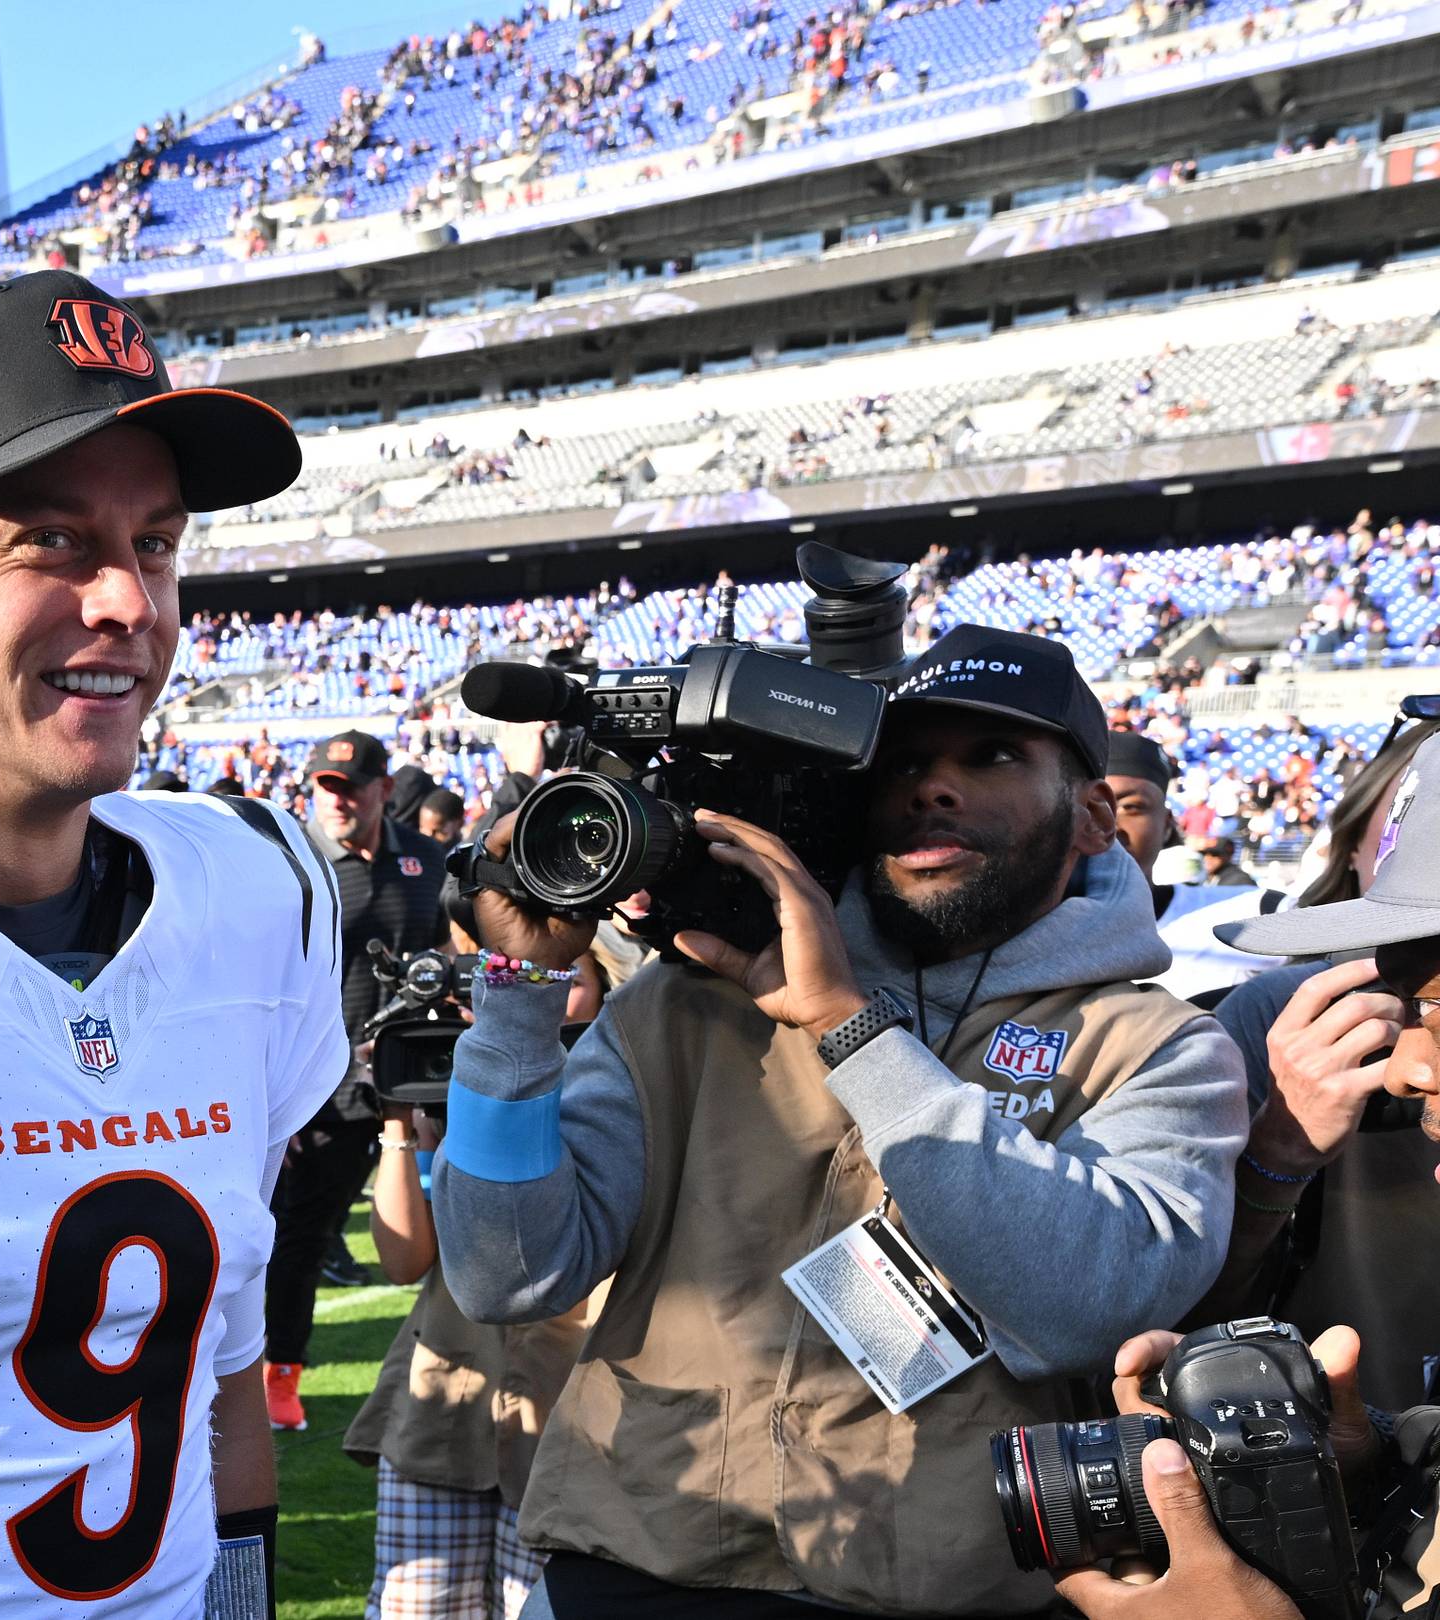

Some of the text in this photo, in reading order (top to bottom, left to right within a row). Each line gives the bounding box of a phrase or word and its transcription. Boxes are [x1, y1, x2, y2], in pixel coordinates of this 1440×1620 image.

[632, 675, 668, 684] SONY
[888, 659, 1022, 702] LULULEMON
[768, 689, 837, 716] XDCAM HD
[416, 972, 436, 981] JVC
[80, 1038, 115, 1069] NFL
[992, 1046, 1051, 1073] NFL
[6, 1169, 220, 1601] 9
[1017, 1463, 1026, 1484] CANON
